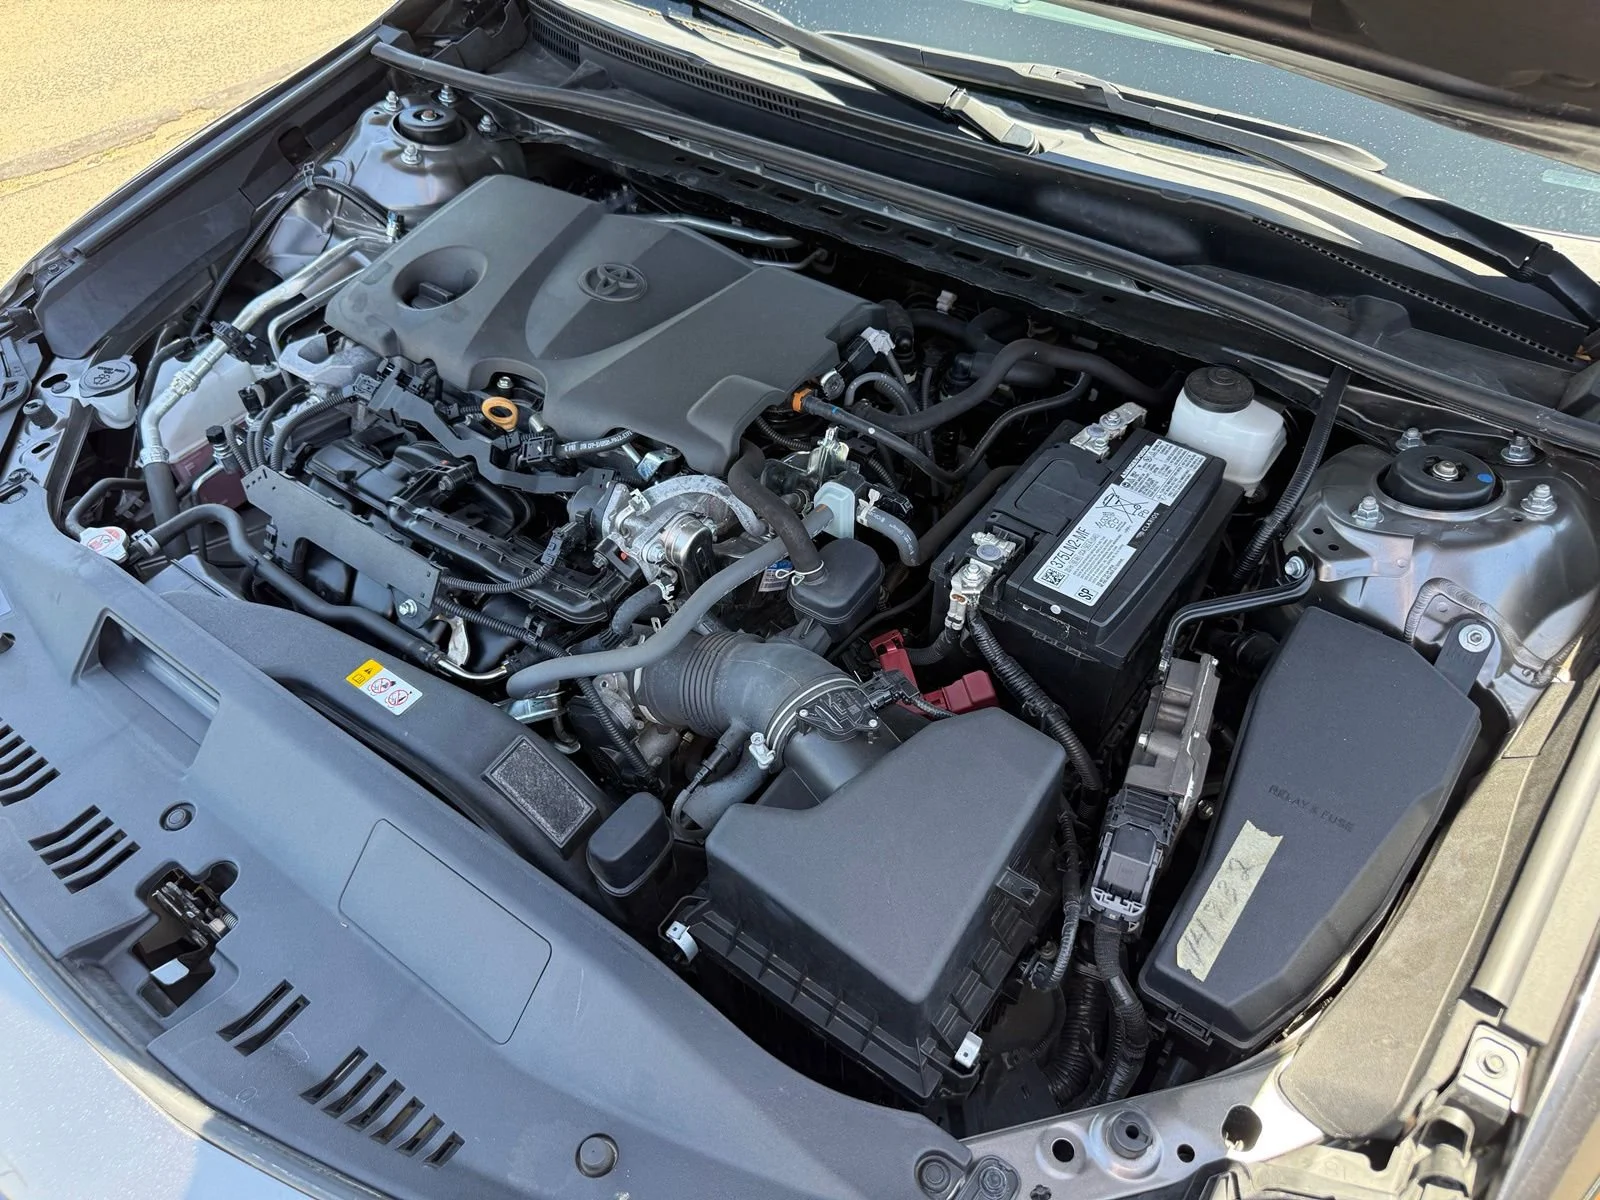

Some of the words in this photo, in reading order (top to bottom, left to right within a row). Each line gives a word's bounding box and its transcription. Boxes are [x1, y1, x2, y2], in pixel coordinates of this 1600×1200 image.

[1142, 511, 1160, 532] CLARIOS
[1050, 526, 1090, 569] 375LN2-MF
[1078, 587, 1094, 601] SP
